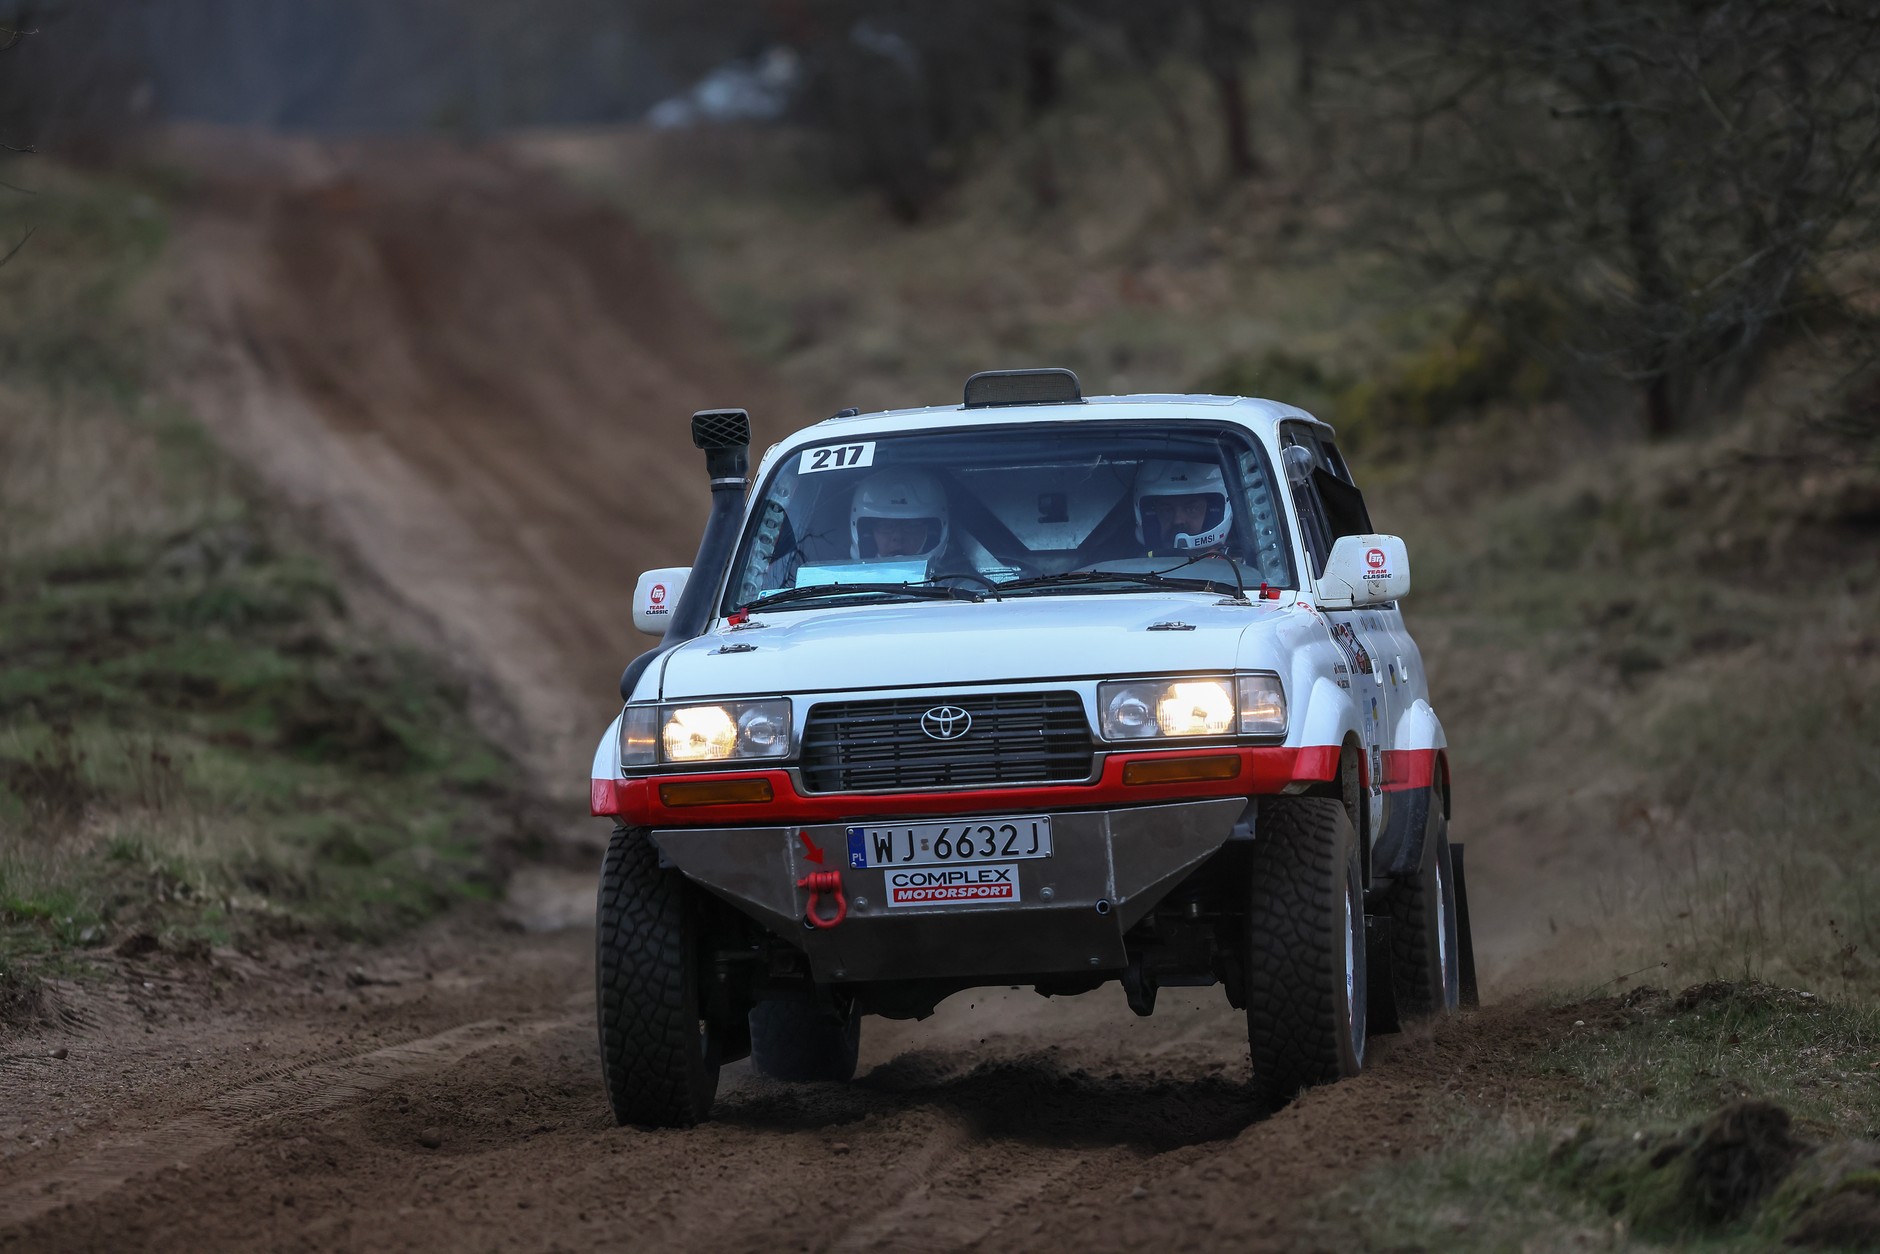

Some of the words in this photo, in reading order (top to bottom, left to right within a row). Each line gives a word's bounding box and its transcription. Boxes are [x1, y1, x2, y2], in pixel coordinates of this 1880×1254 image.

[810, 445, 864, 469] 217
[1194, 534, 1215, 546] EMSI
[872, 828, 915, 864] WJ
[933, 822, 1039, 860] 6632J
[852, 853, 865, 862] PL
[891, 868, 1011, 887] COMPLEX
[897, 885, 1010, 900] MOTORSPORT
